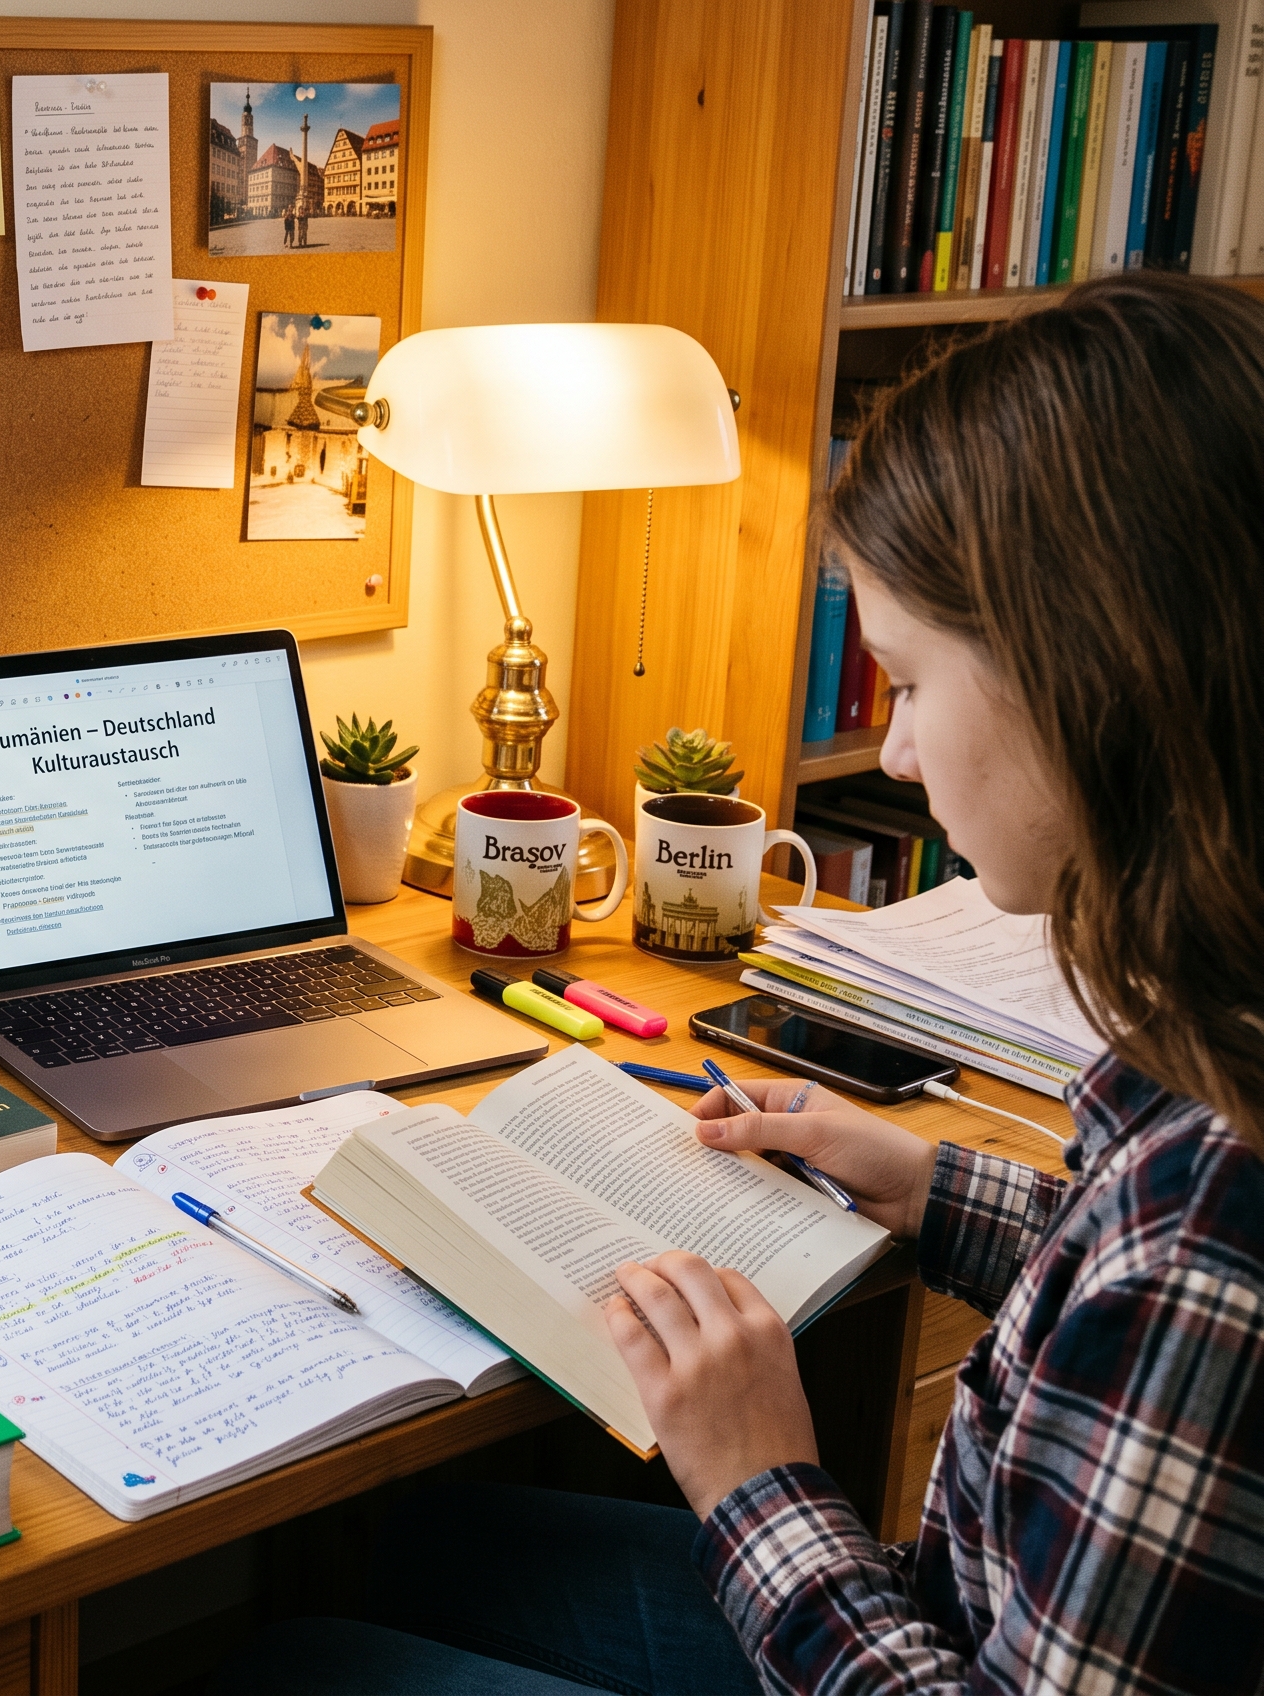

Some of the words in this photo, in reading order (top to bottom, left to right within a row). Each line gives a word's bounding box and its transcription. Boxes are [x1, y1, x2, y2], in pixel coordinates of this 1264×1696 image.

[102, 706, 216, 738] Deutschland
[31, 740, 180, 775] Kulturaustausch
[656, 838, 734, 871] Berlin
